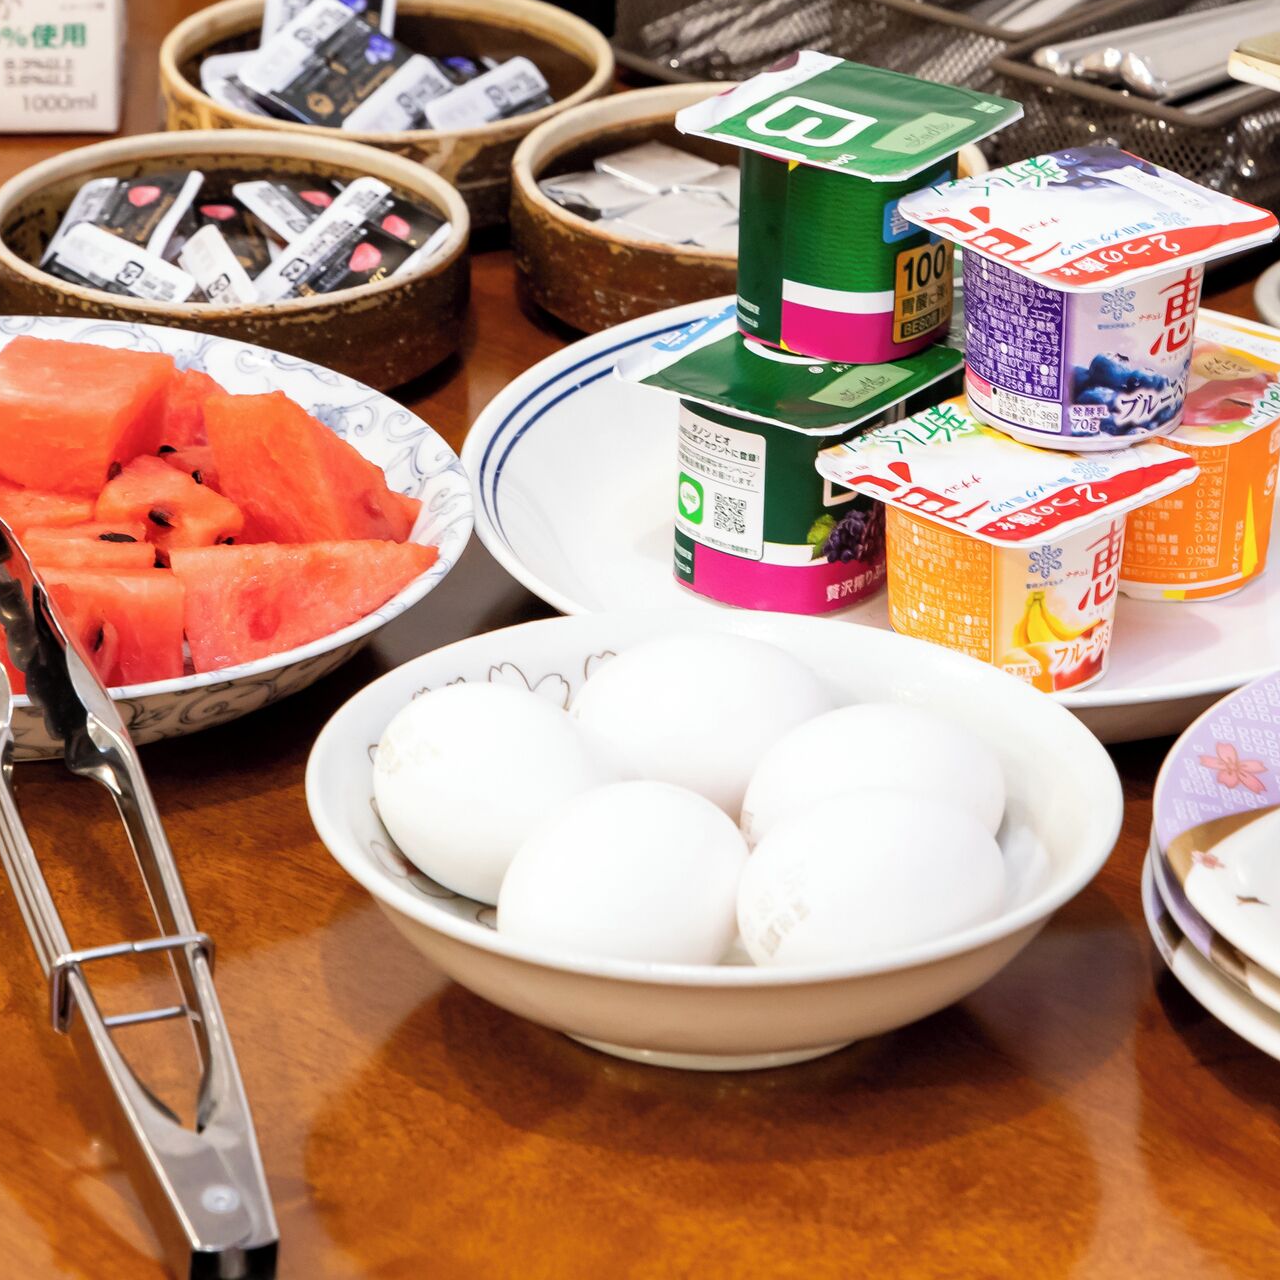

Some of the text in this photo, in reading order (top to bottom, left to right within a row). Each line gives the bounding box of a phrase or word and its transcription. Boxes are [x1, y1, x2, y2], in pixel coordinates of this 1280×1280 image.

[21, 92, 98, 113] 1000ml
[1149, 267, 1203, 356] 恵
[998, 398, 1060, 422] 0120-301-369
[1071, 405, 1108, 418] 発酵乳
[1071, 418, 1099, 433] 70g
[1077, 519, 1126, 612] 恵
